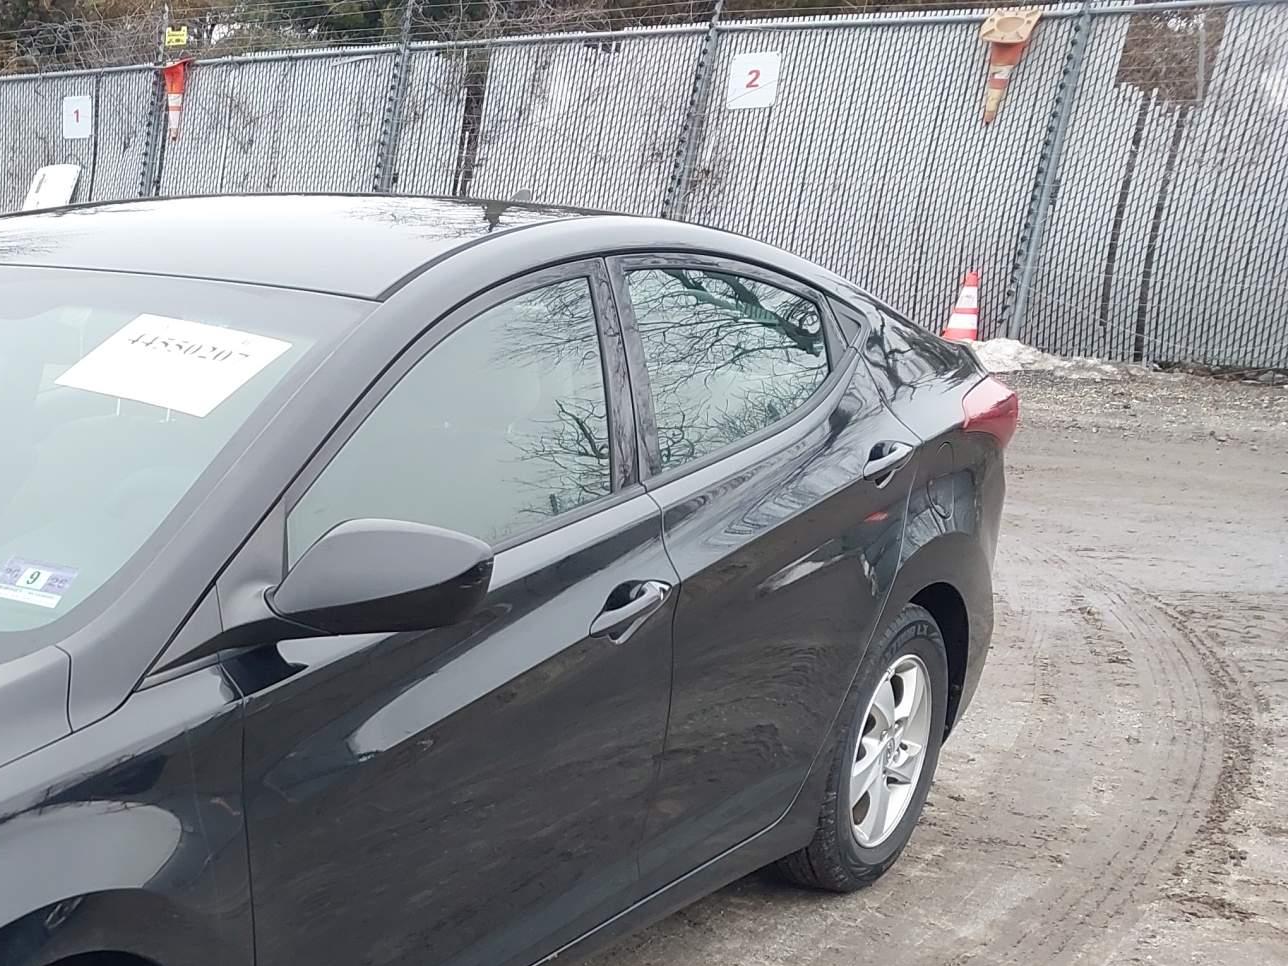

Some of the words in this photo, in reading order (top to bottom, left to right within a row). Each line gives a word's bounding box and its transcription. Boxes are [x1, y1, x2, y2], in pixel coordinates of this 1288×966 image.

[745, 69, 761, 88] 2
[73, 108, 80, 123] 1
[26, 570, 41, 585] 9
